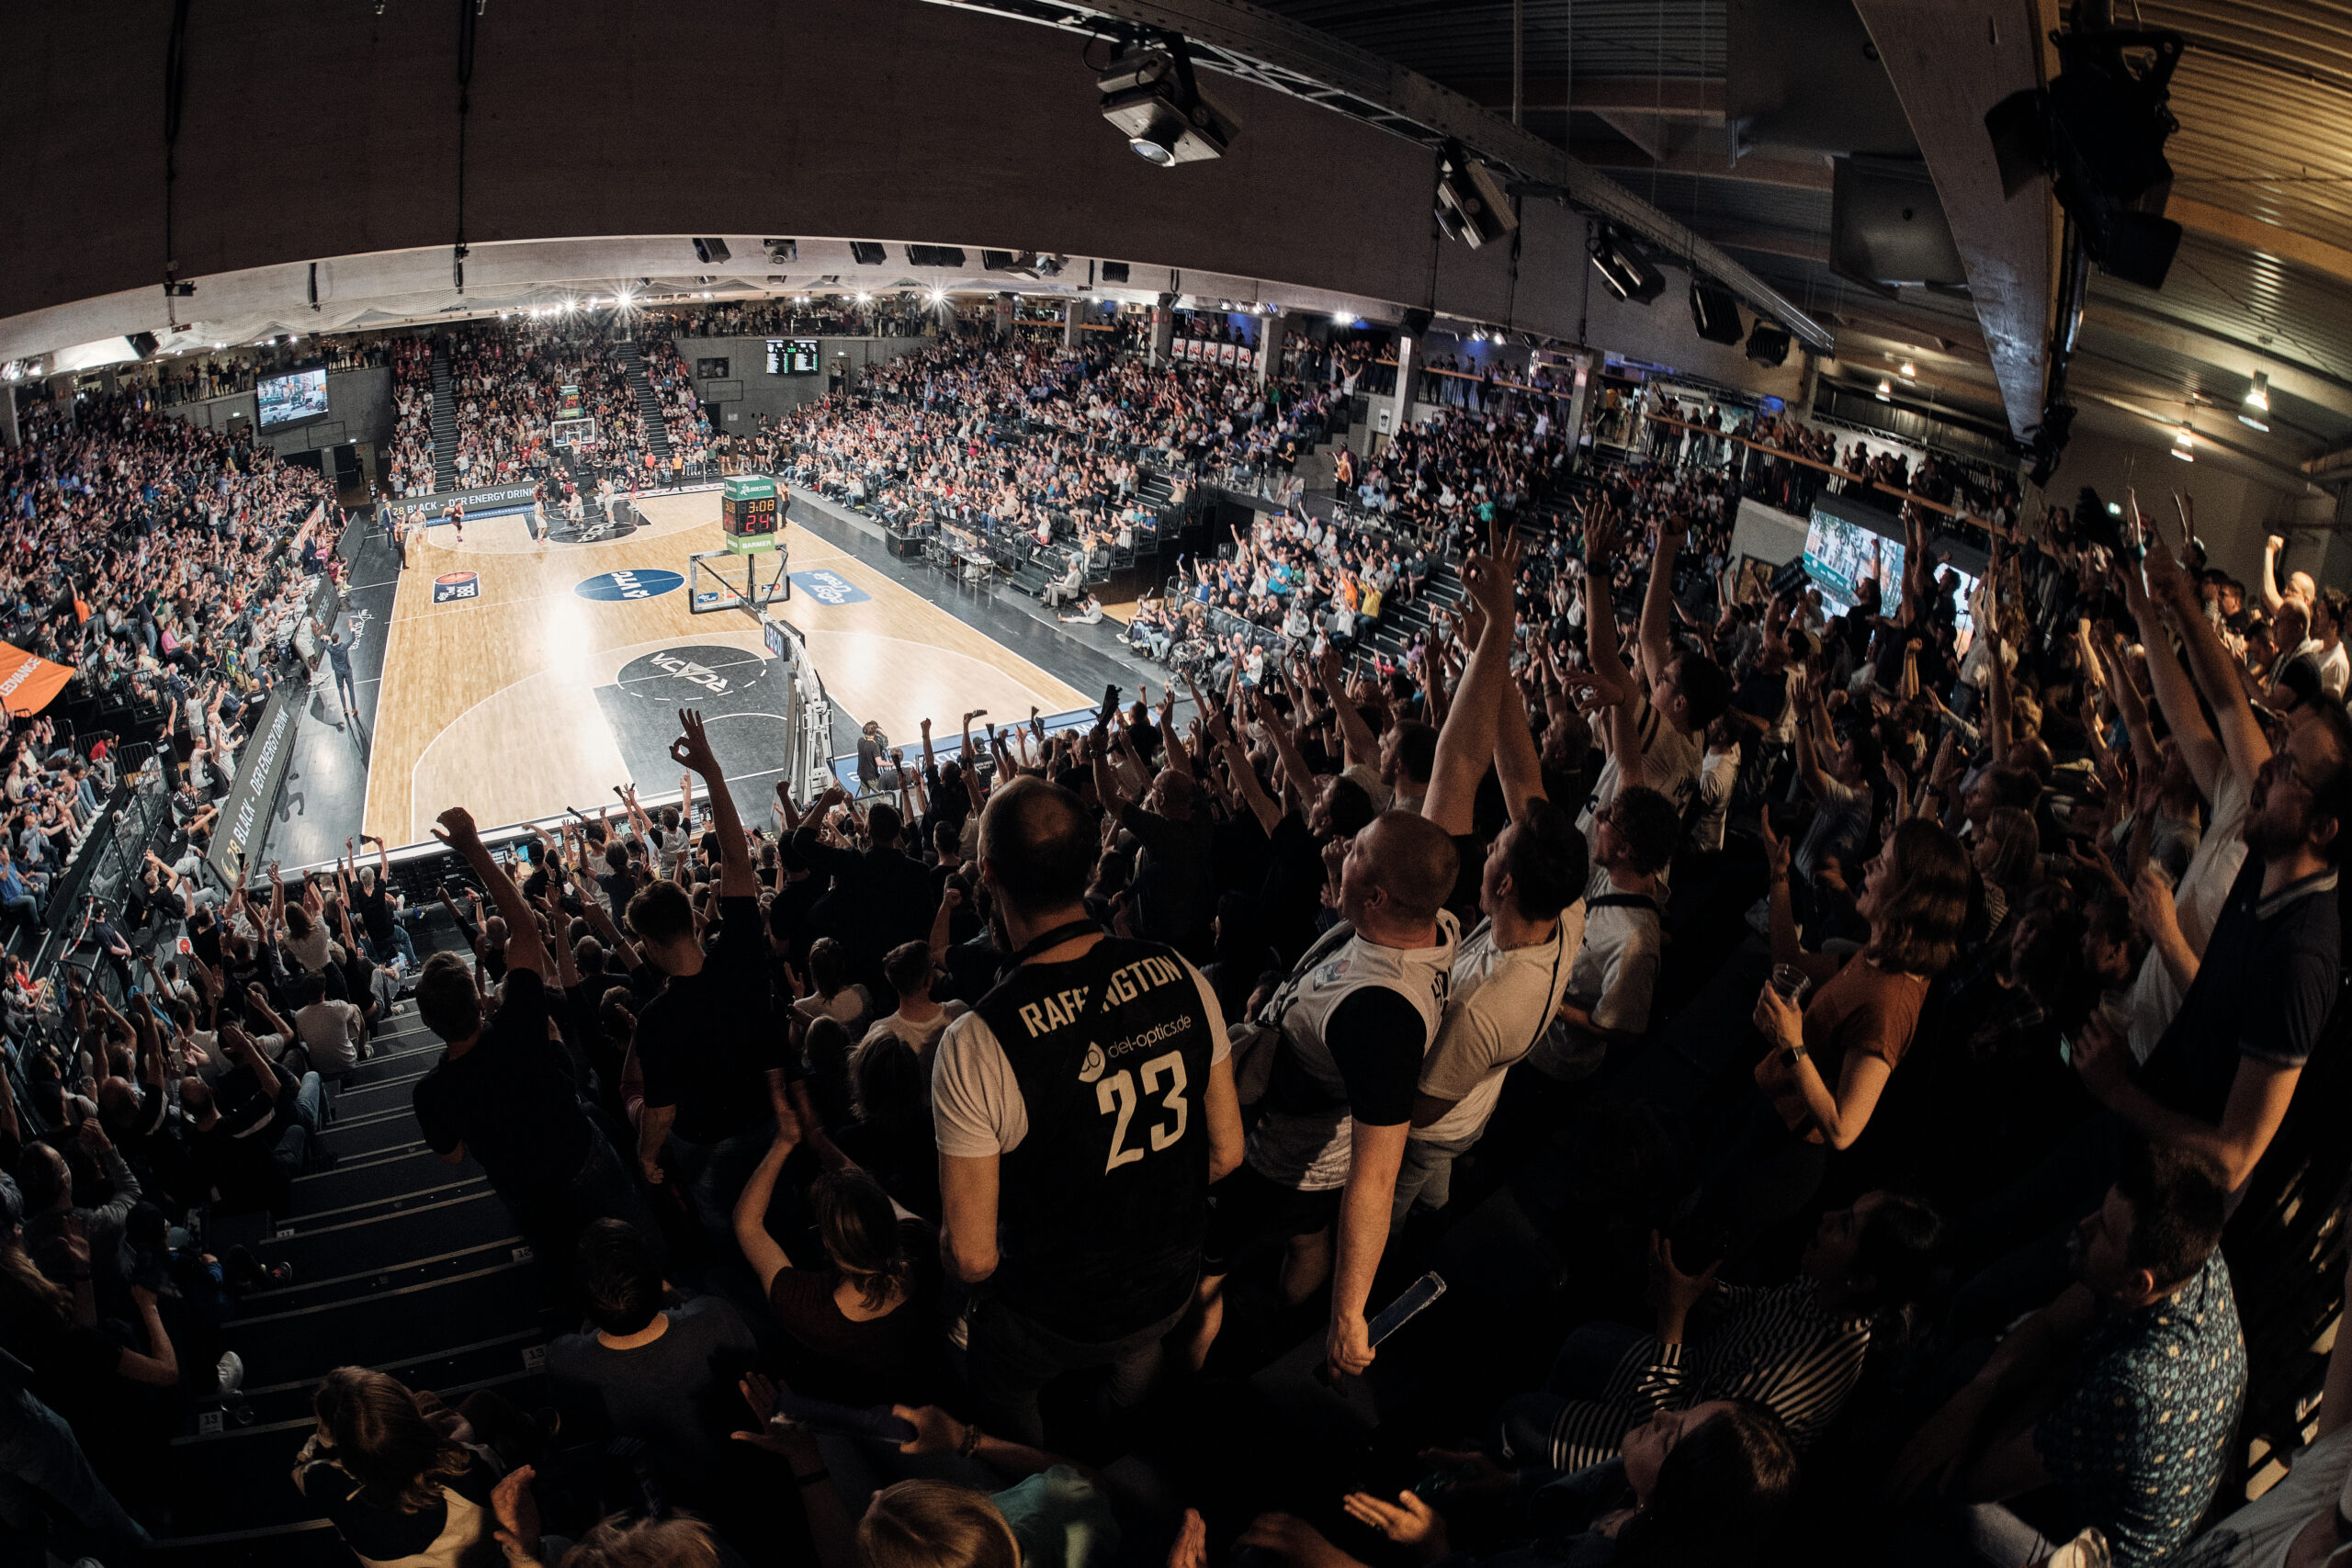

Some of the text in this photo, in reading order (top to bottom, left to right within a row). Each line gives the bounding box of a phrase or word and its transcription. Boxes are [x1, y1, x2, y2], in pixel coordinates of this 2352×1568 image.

[392, 506, 405, 516] 28
[469, 491, 505, 504] ENERGY
[748, 499, 775, 513] 3:08
[745, 513, 770, 533] 24
[742, 540, 772, 548] BARMER
[232, 798, 255, 846] BLACK
[250, 765, 266, 797] DER
[258, 728, 277, 778] ENERGY
[272, 704, 289, 744] DRINK
[1108, 1014, 1192, 1058] del-optics.de
[1096, 1050, 1188, 1177] 23
